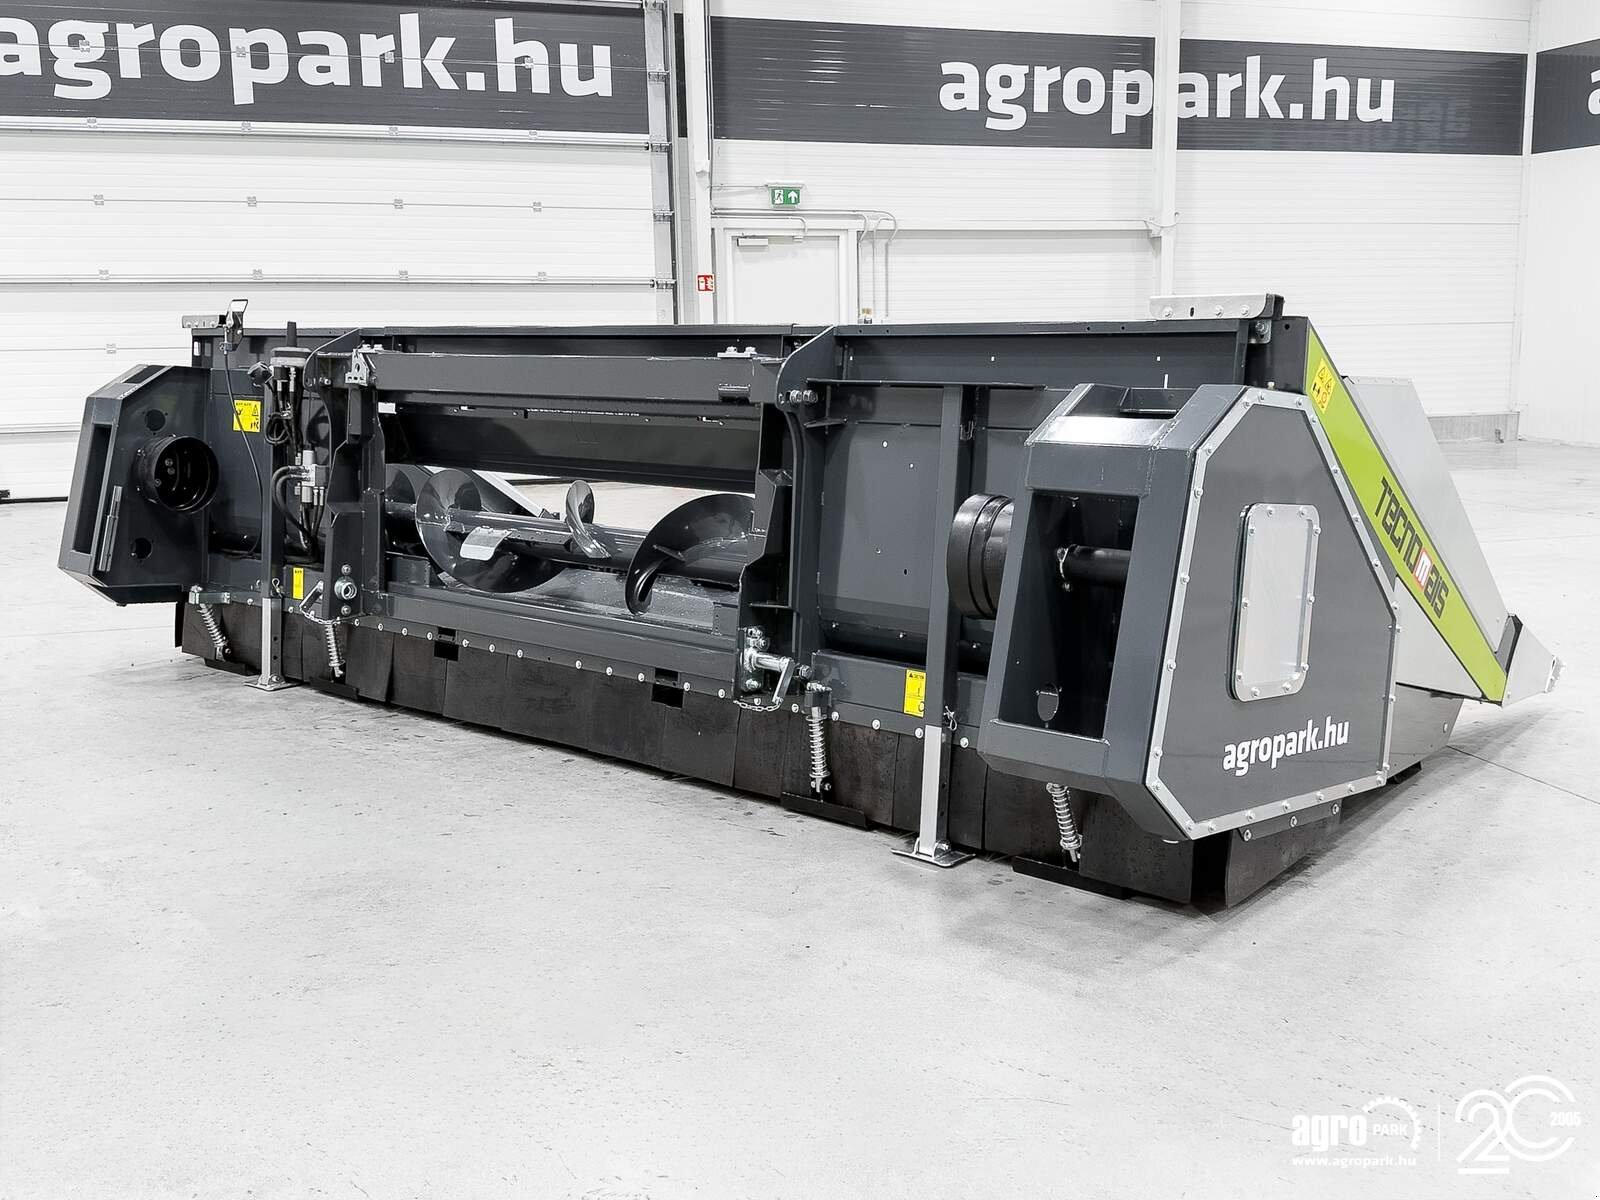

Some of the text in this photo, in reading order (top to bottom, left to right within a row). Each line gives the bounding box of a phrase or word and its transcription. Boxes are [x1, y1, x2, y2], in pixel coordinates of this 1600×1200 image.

[0, 13, 613, 105] agropark.hu
[939, 55, 1395, 135] agropark.hu
[1223, 715, 1349, 777] agropark.hu
